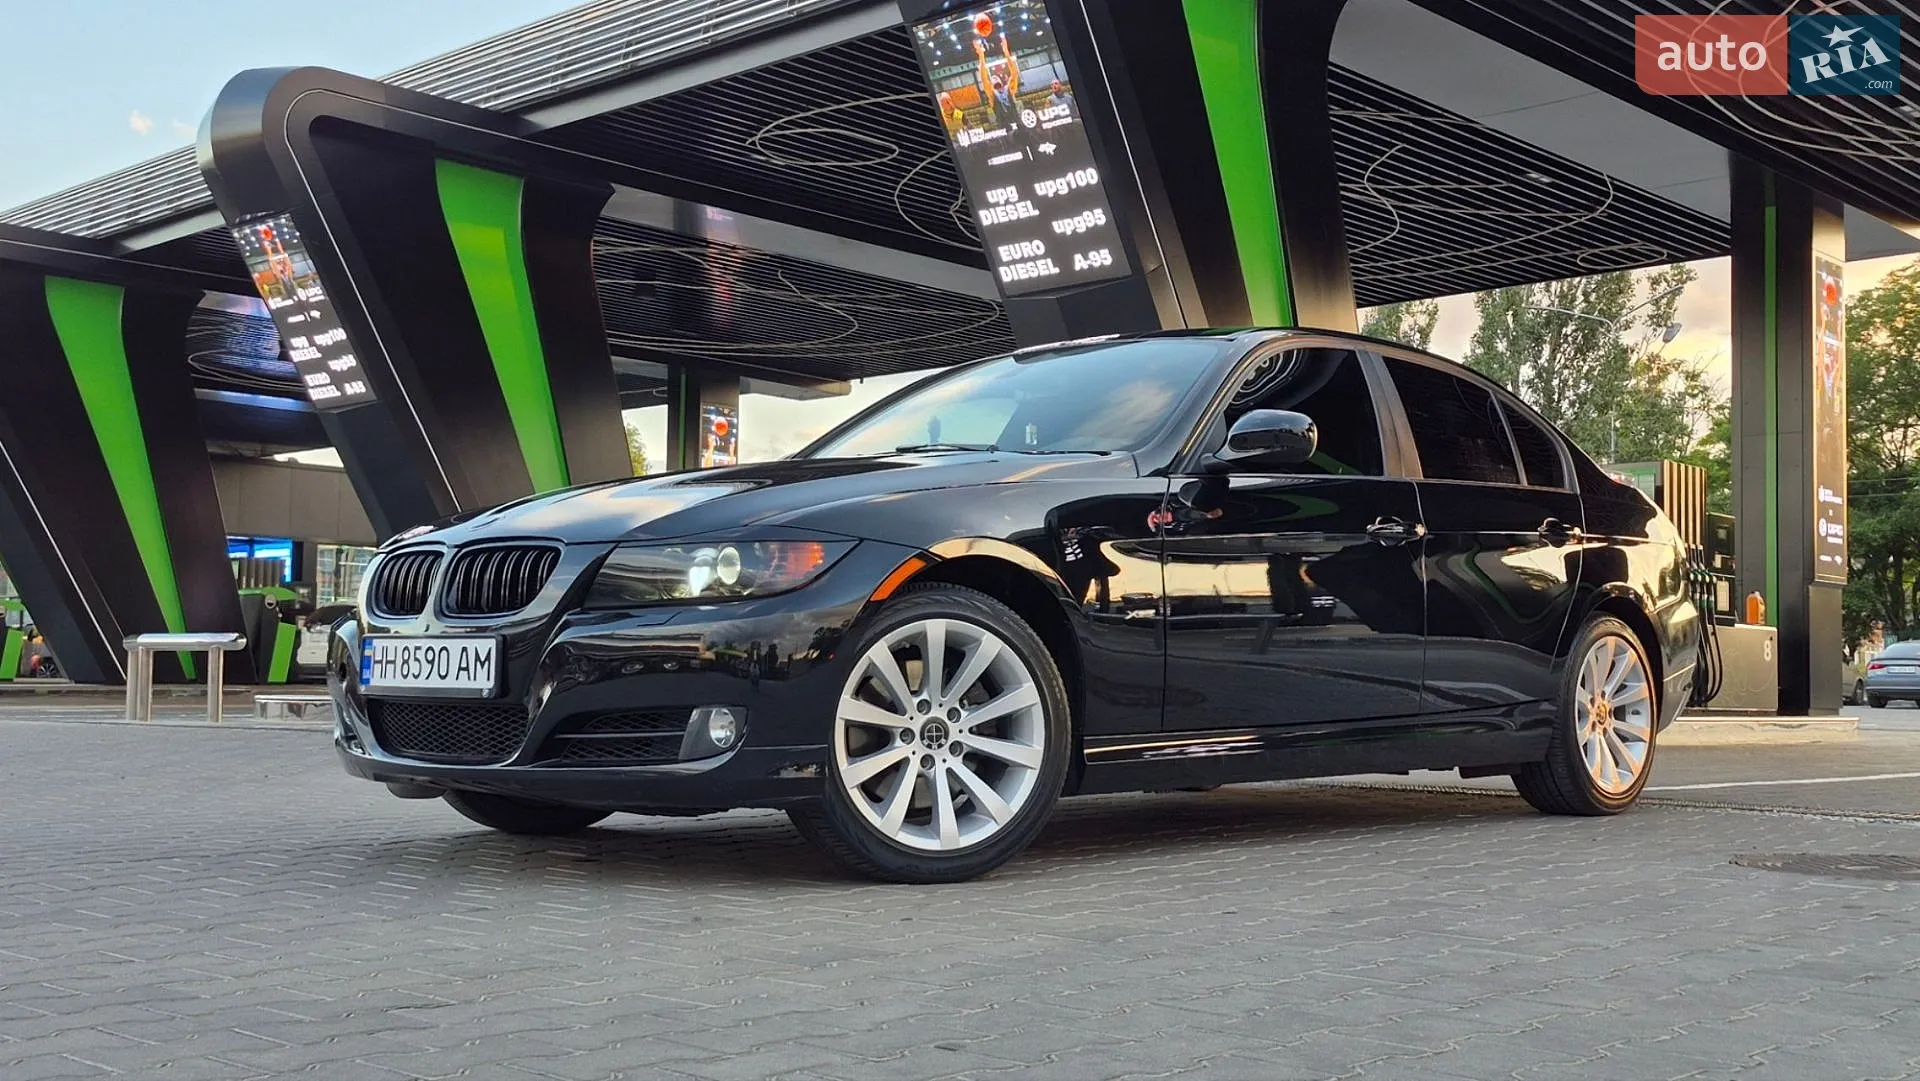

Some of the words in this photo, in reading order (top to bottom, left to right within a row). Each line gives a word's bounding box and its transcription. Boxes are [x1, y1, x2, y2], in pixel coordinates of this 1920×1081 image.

[1037, 103, 1070, 121] UPG
[1034, 168, 1098, 197] upg100
[986, 185, 1018, 204] upg
[979, 200, 1039, 226] DIESEL
[1052, 208, 1106, 236] upg95
[998, 239, 1045, 262] EURO
[1073, 249, 1113, 271] A-95
[999, 258, 1060, 282] DIESEL
[1764, 639, 1771, 661] 8
[455, 646, 492, 681] AM
